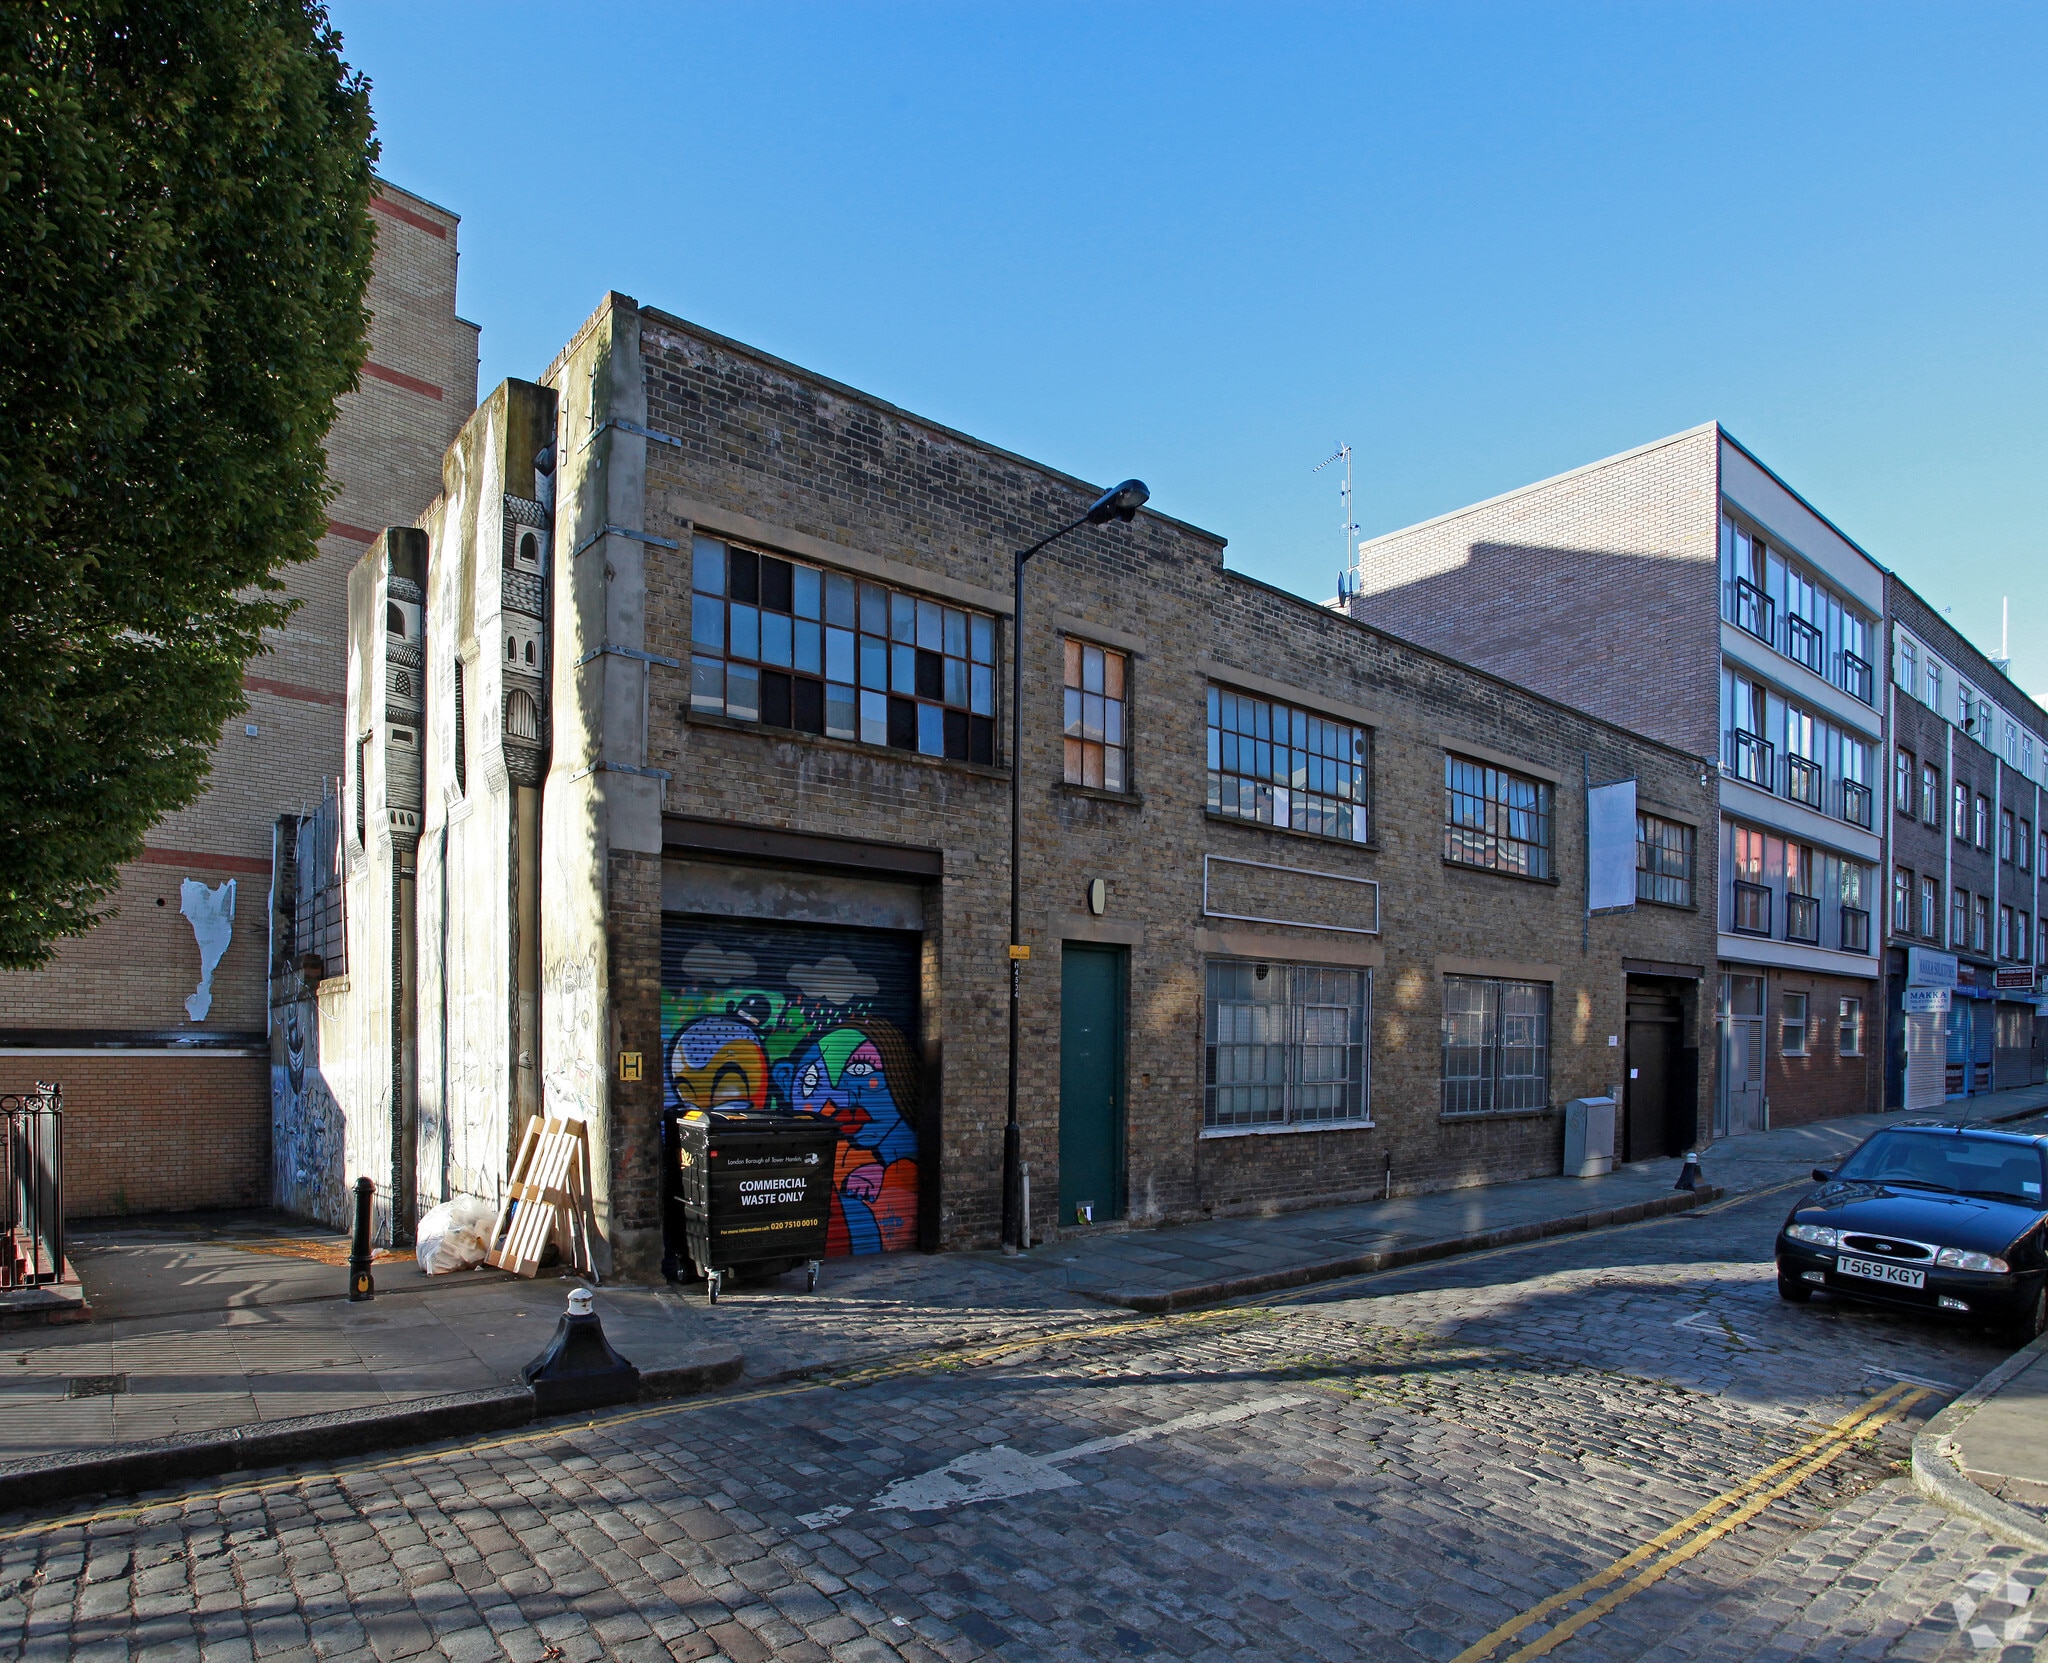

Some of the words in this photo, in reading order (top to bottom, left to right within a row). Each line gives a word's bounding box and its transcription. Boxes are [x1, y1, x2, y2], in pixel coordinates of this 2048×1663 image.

[1910, 991, 1946, 999] MAKKA
[624, 1055, 639, 1077] H
[745, 1157, 764, 1165] Borough
[740, 1177, 807, 1191] COMMERCIAL
[741, 1194, 776, 1206] WASTE
[778, 1191, 804, 1202] ONLY
[770, 1222, 784, 1230] 020
[785, 1220, 801, 1229] 7510
[802, 1218, 818, 1227] 0010
[1841, 1258, 1882, 1277] T569
[1887, 1267, 1921, 1284] KGY
